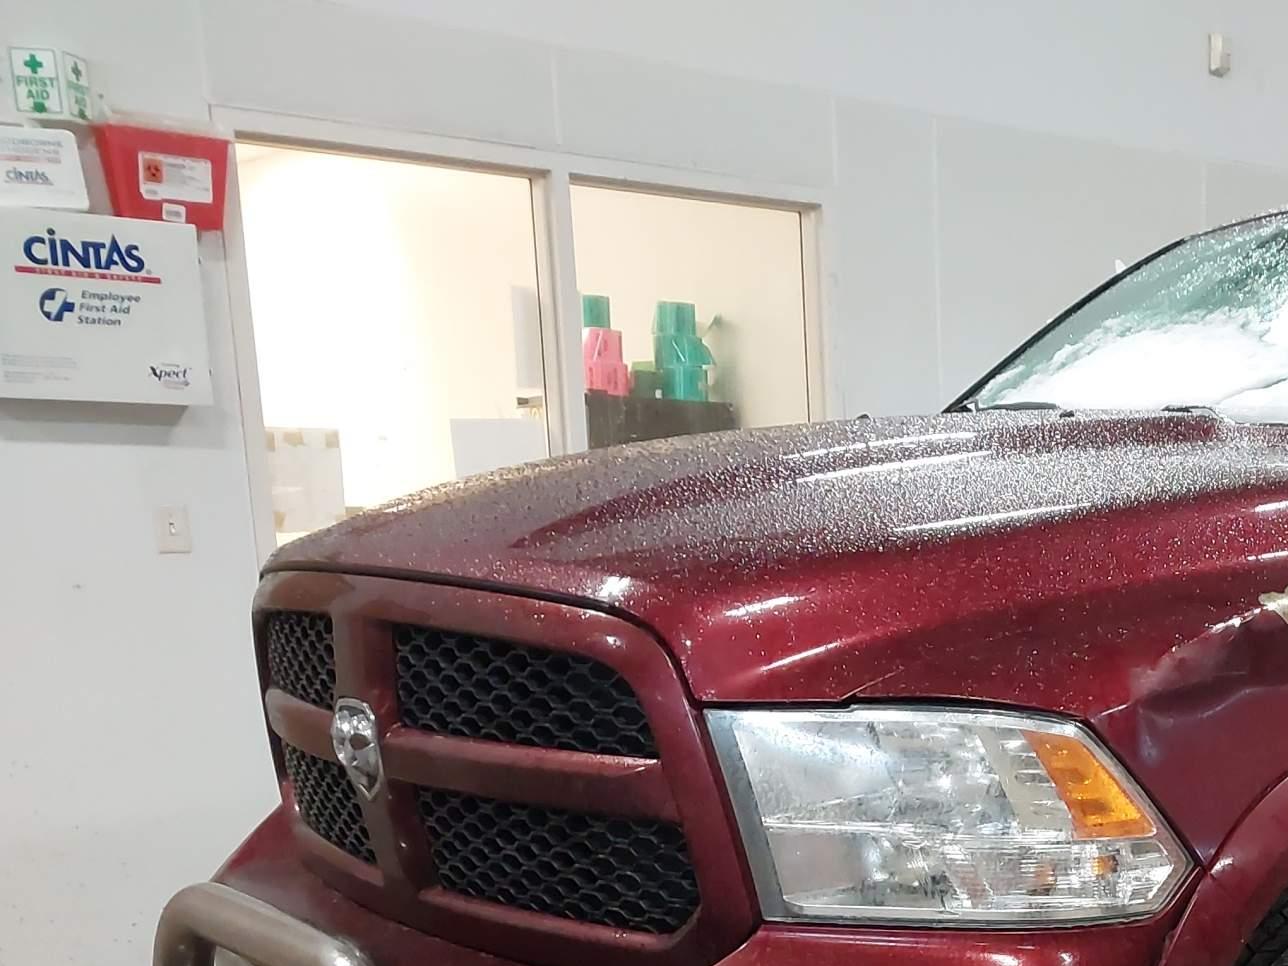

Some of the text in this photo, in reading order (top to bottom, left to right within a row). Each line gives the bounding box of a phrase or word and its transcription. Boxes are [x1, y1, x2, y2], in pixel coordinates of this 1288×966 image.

[16, 75, 56, 88] FIRST
[26, 89, 50, 100] AID
[81, 289, 141, 303] Employee
[79, 302, 131, 315] First Aid
[77, 315, 122, 326] Station
